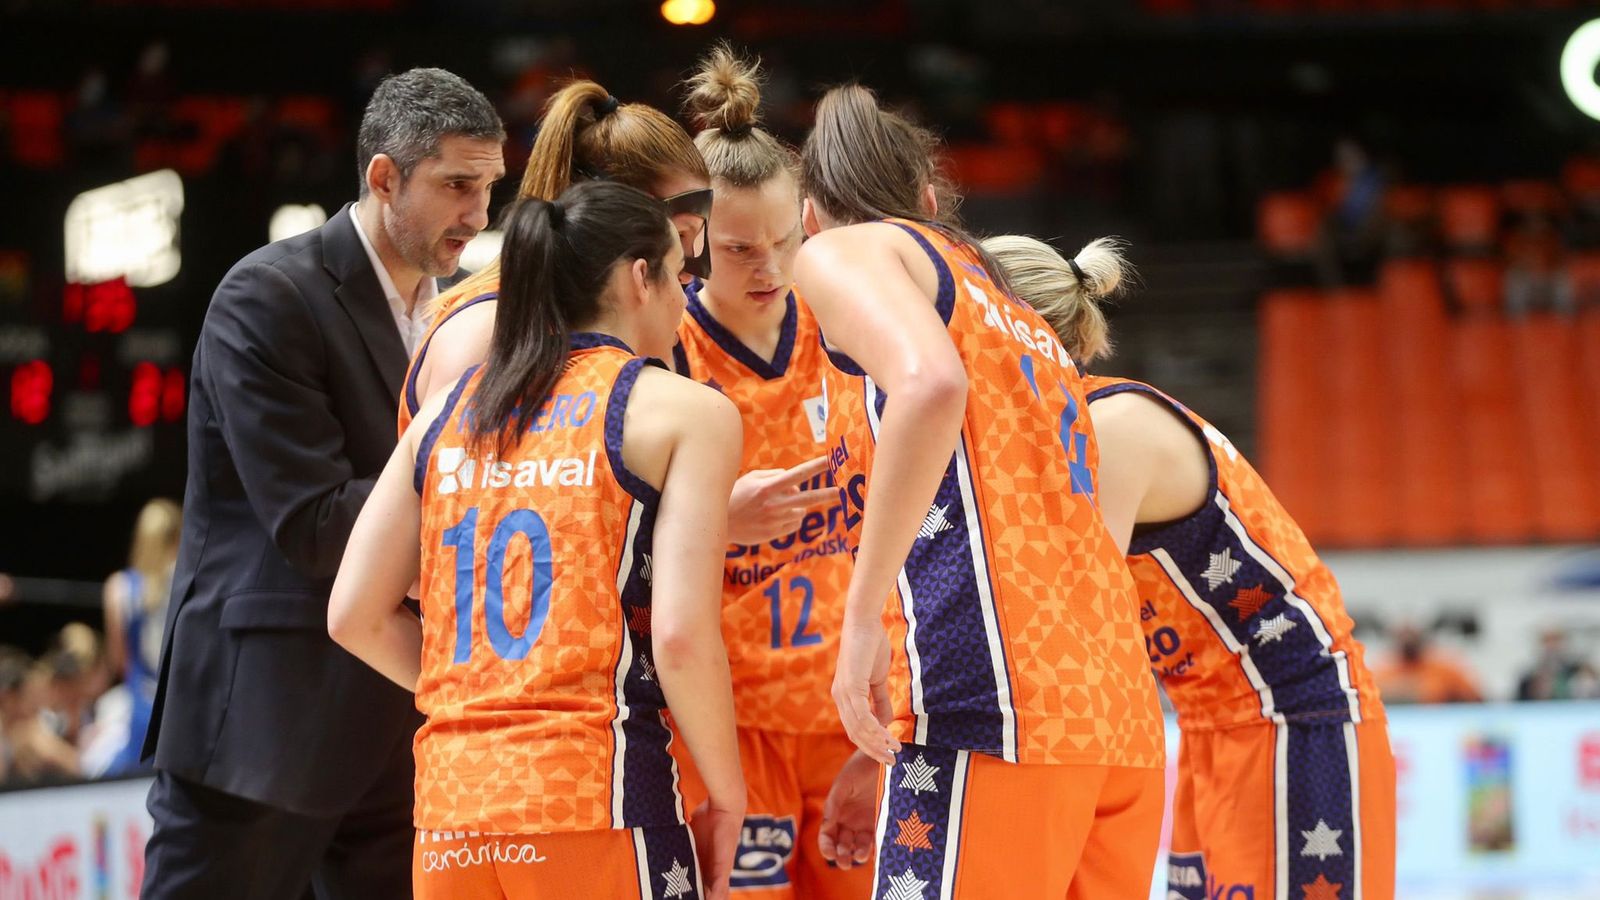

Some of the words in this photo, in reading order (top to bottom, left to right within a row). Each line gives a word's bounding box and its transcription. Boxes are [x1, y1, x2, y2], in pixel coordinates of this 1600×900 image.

[1003, 303, 1076, 369] isav
[481, 448, 598, 489] isaval
[441, 506, 554, 664] 10
[763, 575, 824, 651] 12
